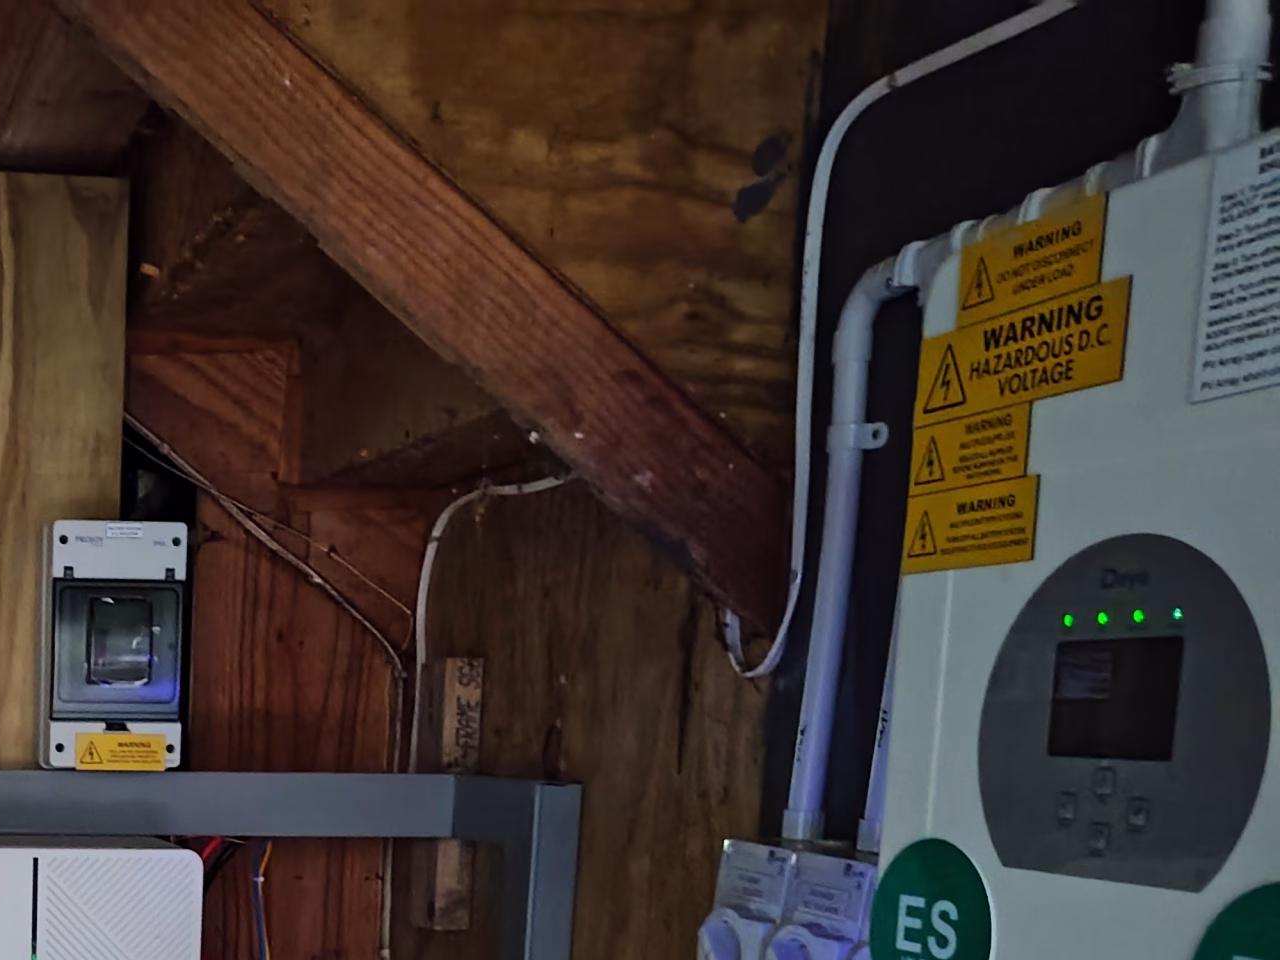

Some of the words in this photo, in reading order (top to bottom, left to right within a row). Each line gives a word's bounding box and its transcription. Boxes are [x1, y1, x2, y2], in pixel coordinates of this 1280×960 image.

[1012, 220, 1082, 259] WARNING
[983, 295, 1104, 352] WARNING
[969, 332, 1074, 381] HAZARDOUS
[997, 359, 1075, 397] VOLTAGE
[956, 494, 1016, 515] WARNING
[895, 893, 959, 960] ES
